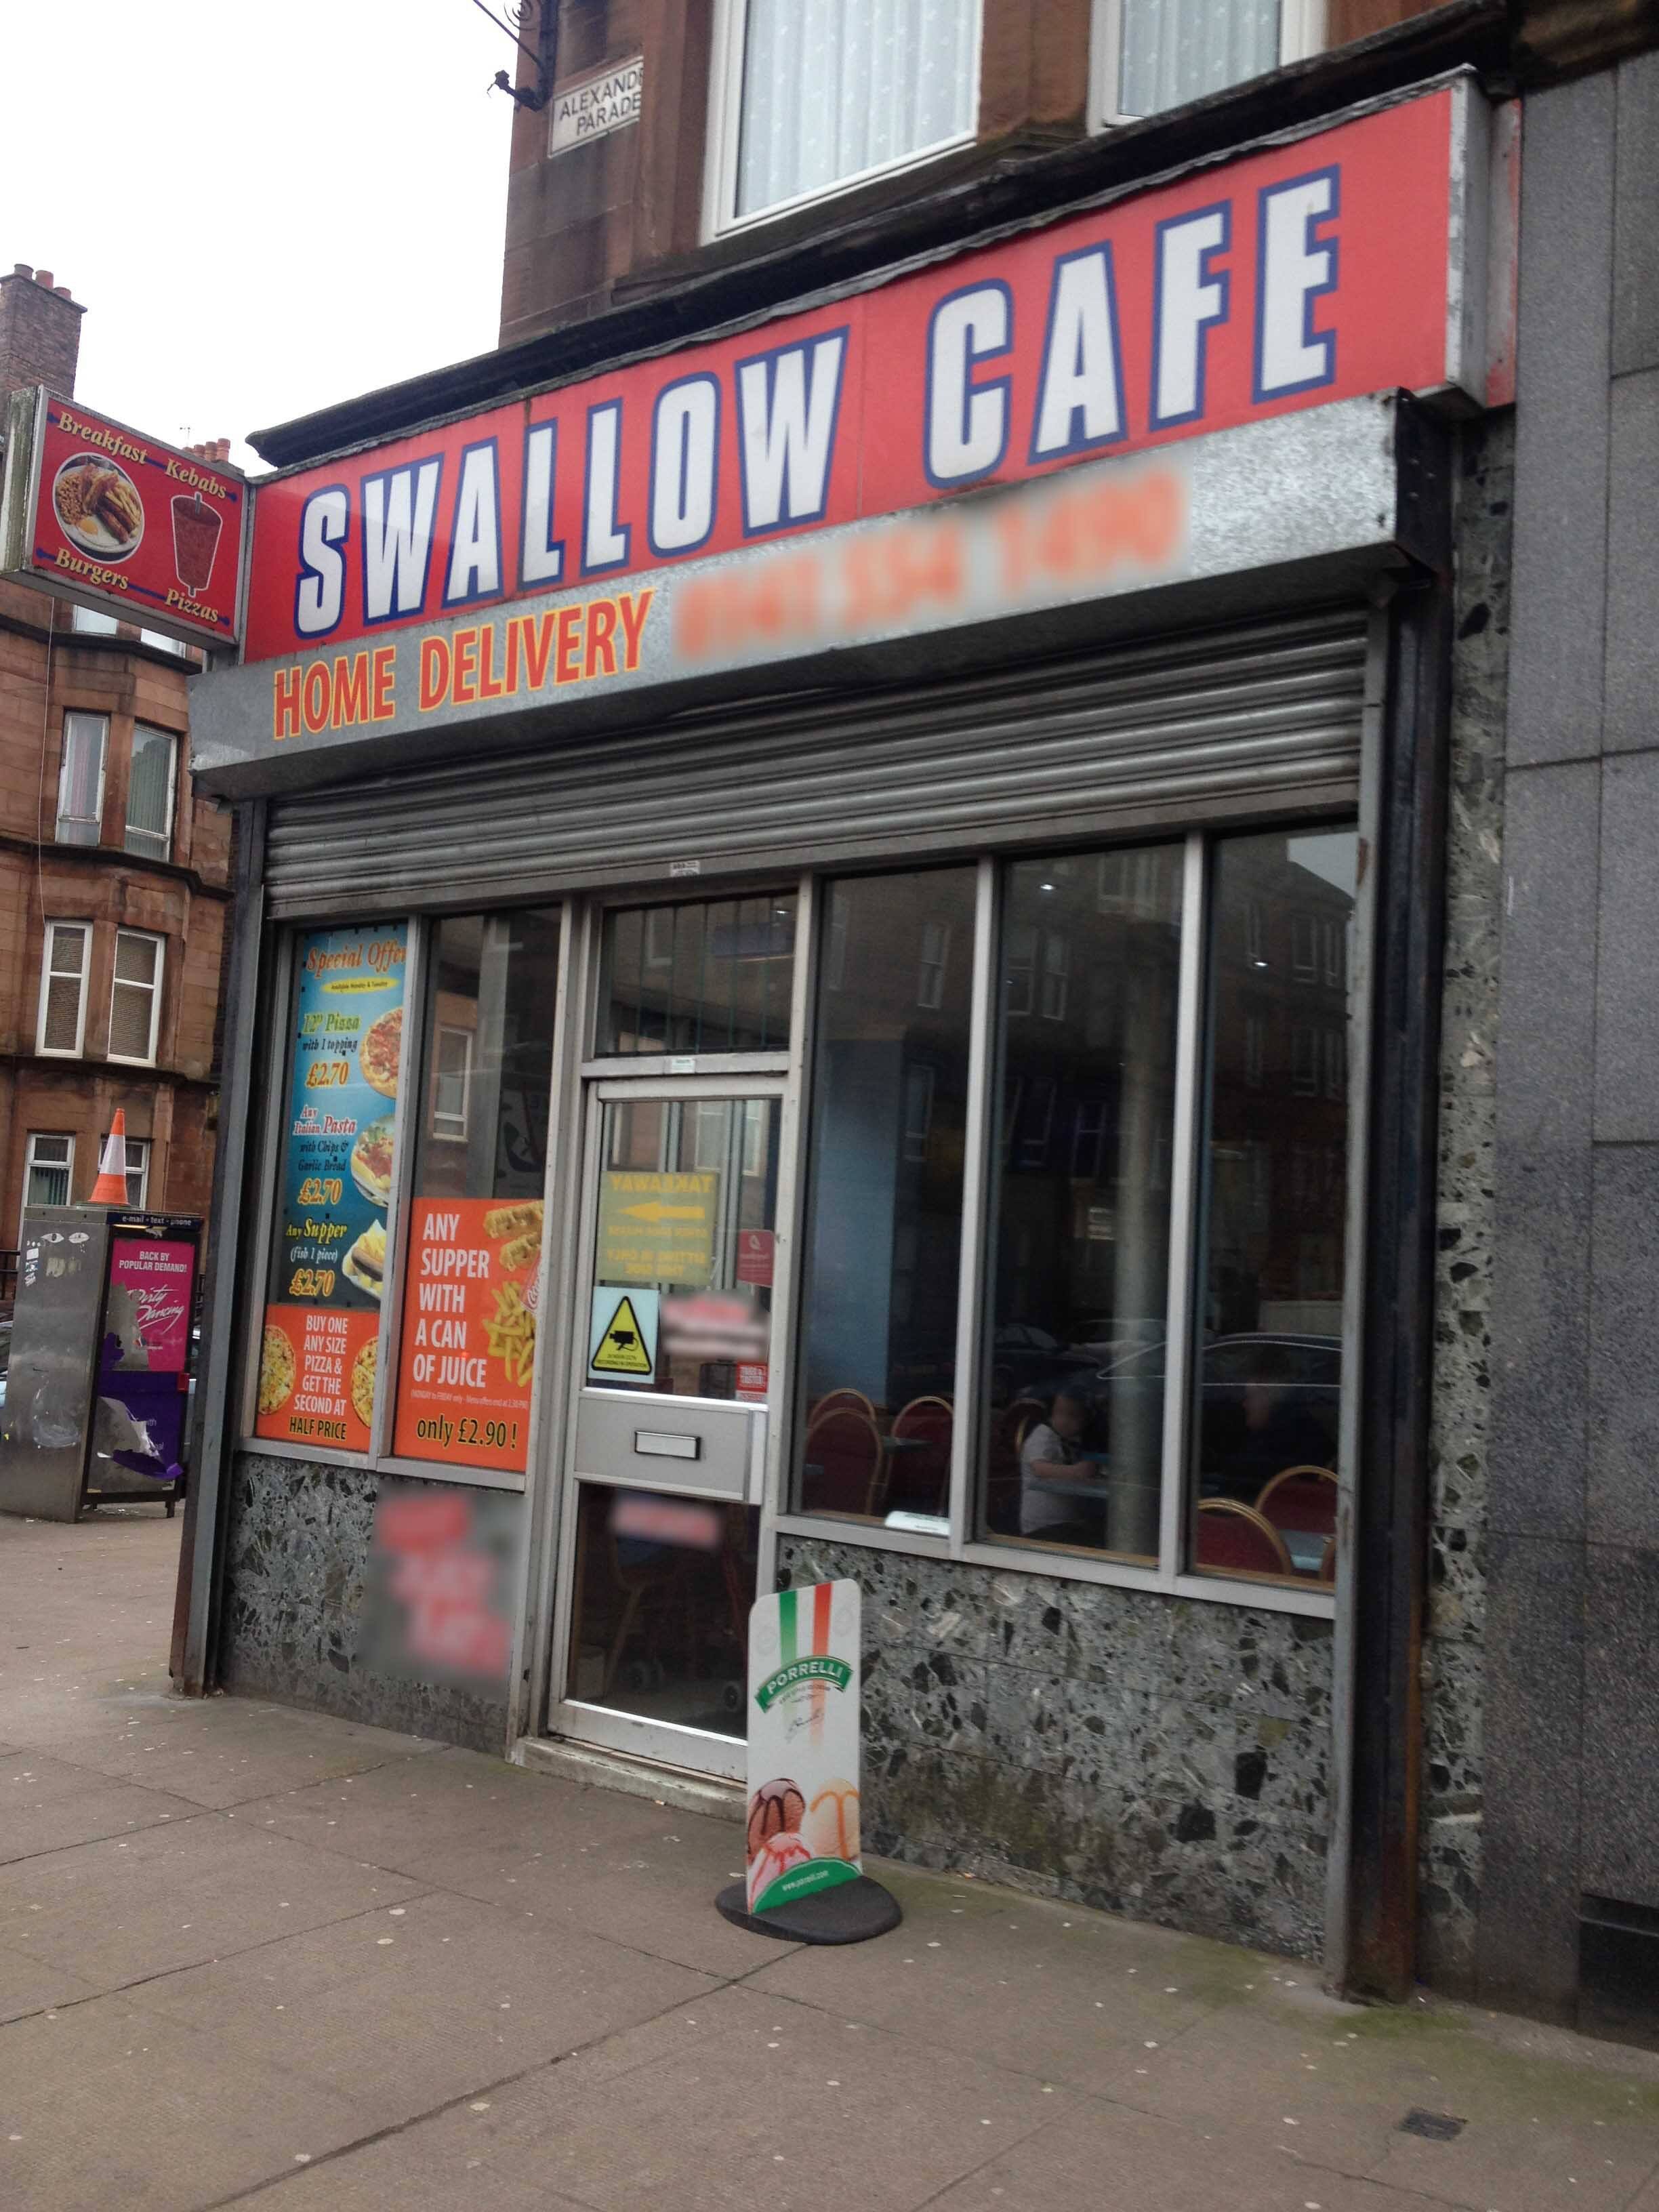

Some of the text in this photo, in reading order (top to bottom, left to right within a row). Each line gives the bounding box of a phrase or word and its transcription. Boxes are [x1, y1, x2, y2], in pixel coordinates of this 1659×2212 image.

[577, 91, 641, 136] PARADE
[294, 325, 850, 639] SWALLOW
[923, 163, 1341, 489] CAFE
[57, 411, 227, 499] Breakfast Kebabs
[54, 548, 219, 623] Burgers Pizzas
[272, 586, 657, 741] HOME DELIVERY
[306, 943, 364, 979] Special
[325, 1012, 361, 1032] Pizza
[302, 1038, 319, 1051] with
[327, 1036, 358, 1053] topping
[306, 1061, 349, 1088] £2.70
[323, 1115, 357, 1134] Pasta
[300, 1140, 316, 1152] with
[318, 1140, 339, 1156] Chips
[298, 1159, 347, 1172] Garlic Bread
[298, 1178, 342, 1206] £2.70
[286, 1218, 348, 1244] Any Supper
[422, 1213, 459, 1242] ANY
[119, 1260, 188, 1273] POPULAR DEMAND!
[140, 1251, 170, 1261] BACK BY
[290, 1246, 308, 1263] (fish
[420, 1248, 490, 1279] SUPPER
[289, 1269, 335, 1297] £2.70
[418, 1282, 466, 1313] WITH
[306, 1315, 348, 1334] BUY ONE
[415, 1318, 467, 1350] A CAN
[304, 1334, 347, 1355] ANY SIZE
[304, 1355, 342, 1375] PIZZA &
[413, 1353, 487, 1388] OF JUICE
[302, 1375, 342, 1395] GET THE
[293, 1394, 347, 1416] SECOND AT
[289, 1416, 347, 1440] HALF PRICE
[417, 1412, 454, 1450] only
[457, 1416, 507, 1448] £2.90
[767, 1661, 843, 1694] PORRELLI
